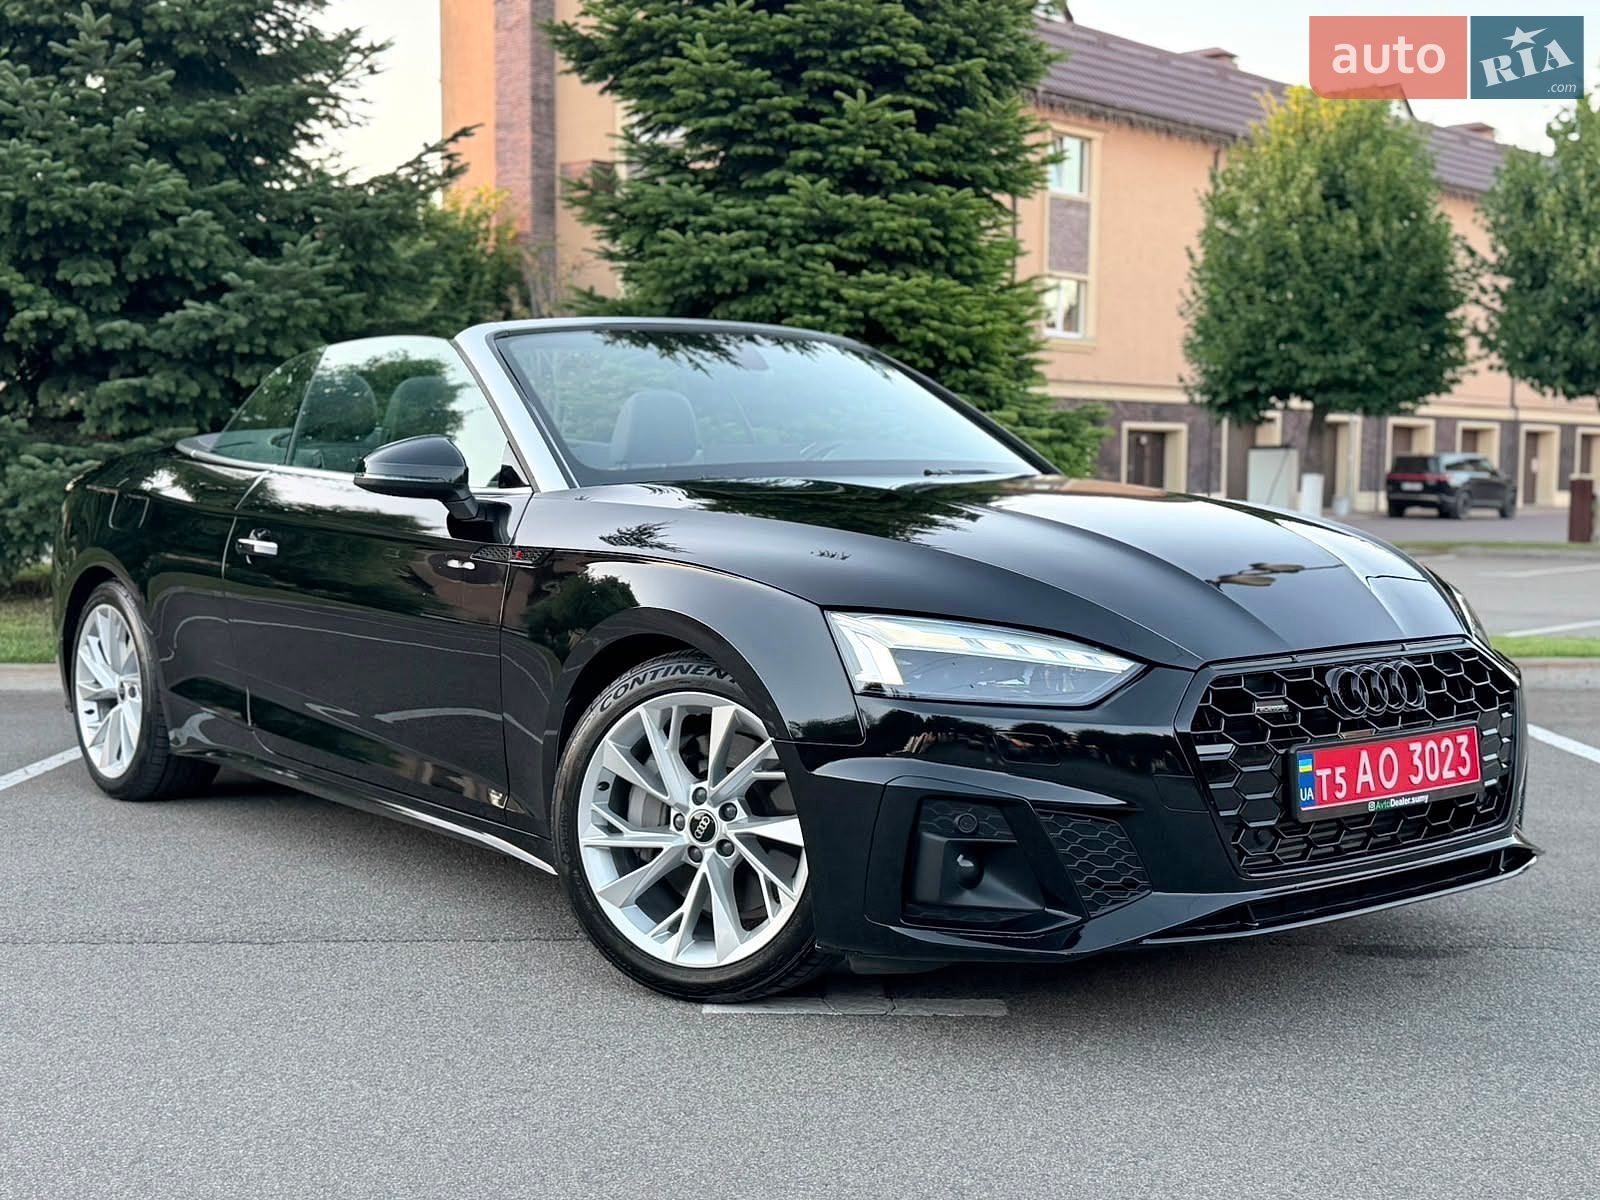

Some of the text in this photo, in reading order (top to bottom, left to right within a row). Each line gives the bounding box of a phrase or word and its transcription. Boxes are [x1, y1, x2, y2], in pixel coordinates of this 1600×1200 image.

[1315, 734, 1471, 801] T5 AO 3023
[1300, 787, 1315, 801] UA
